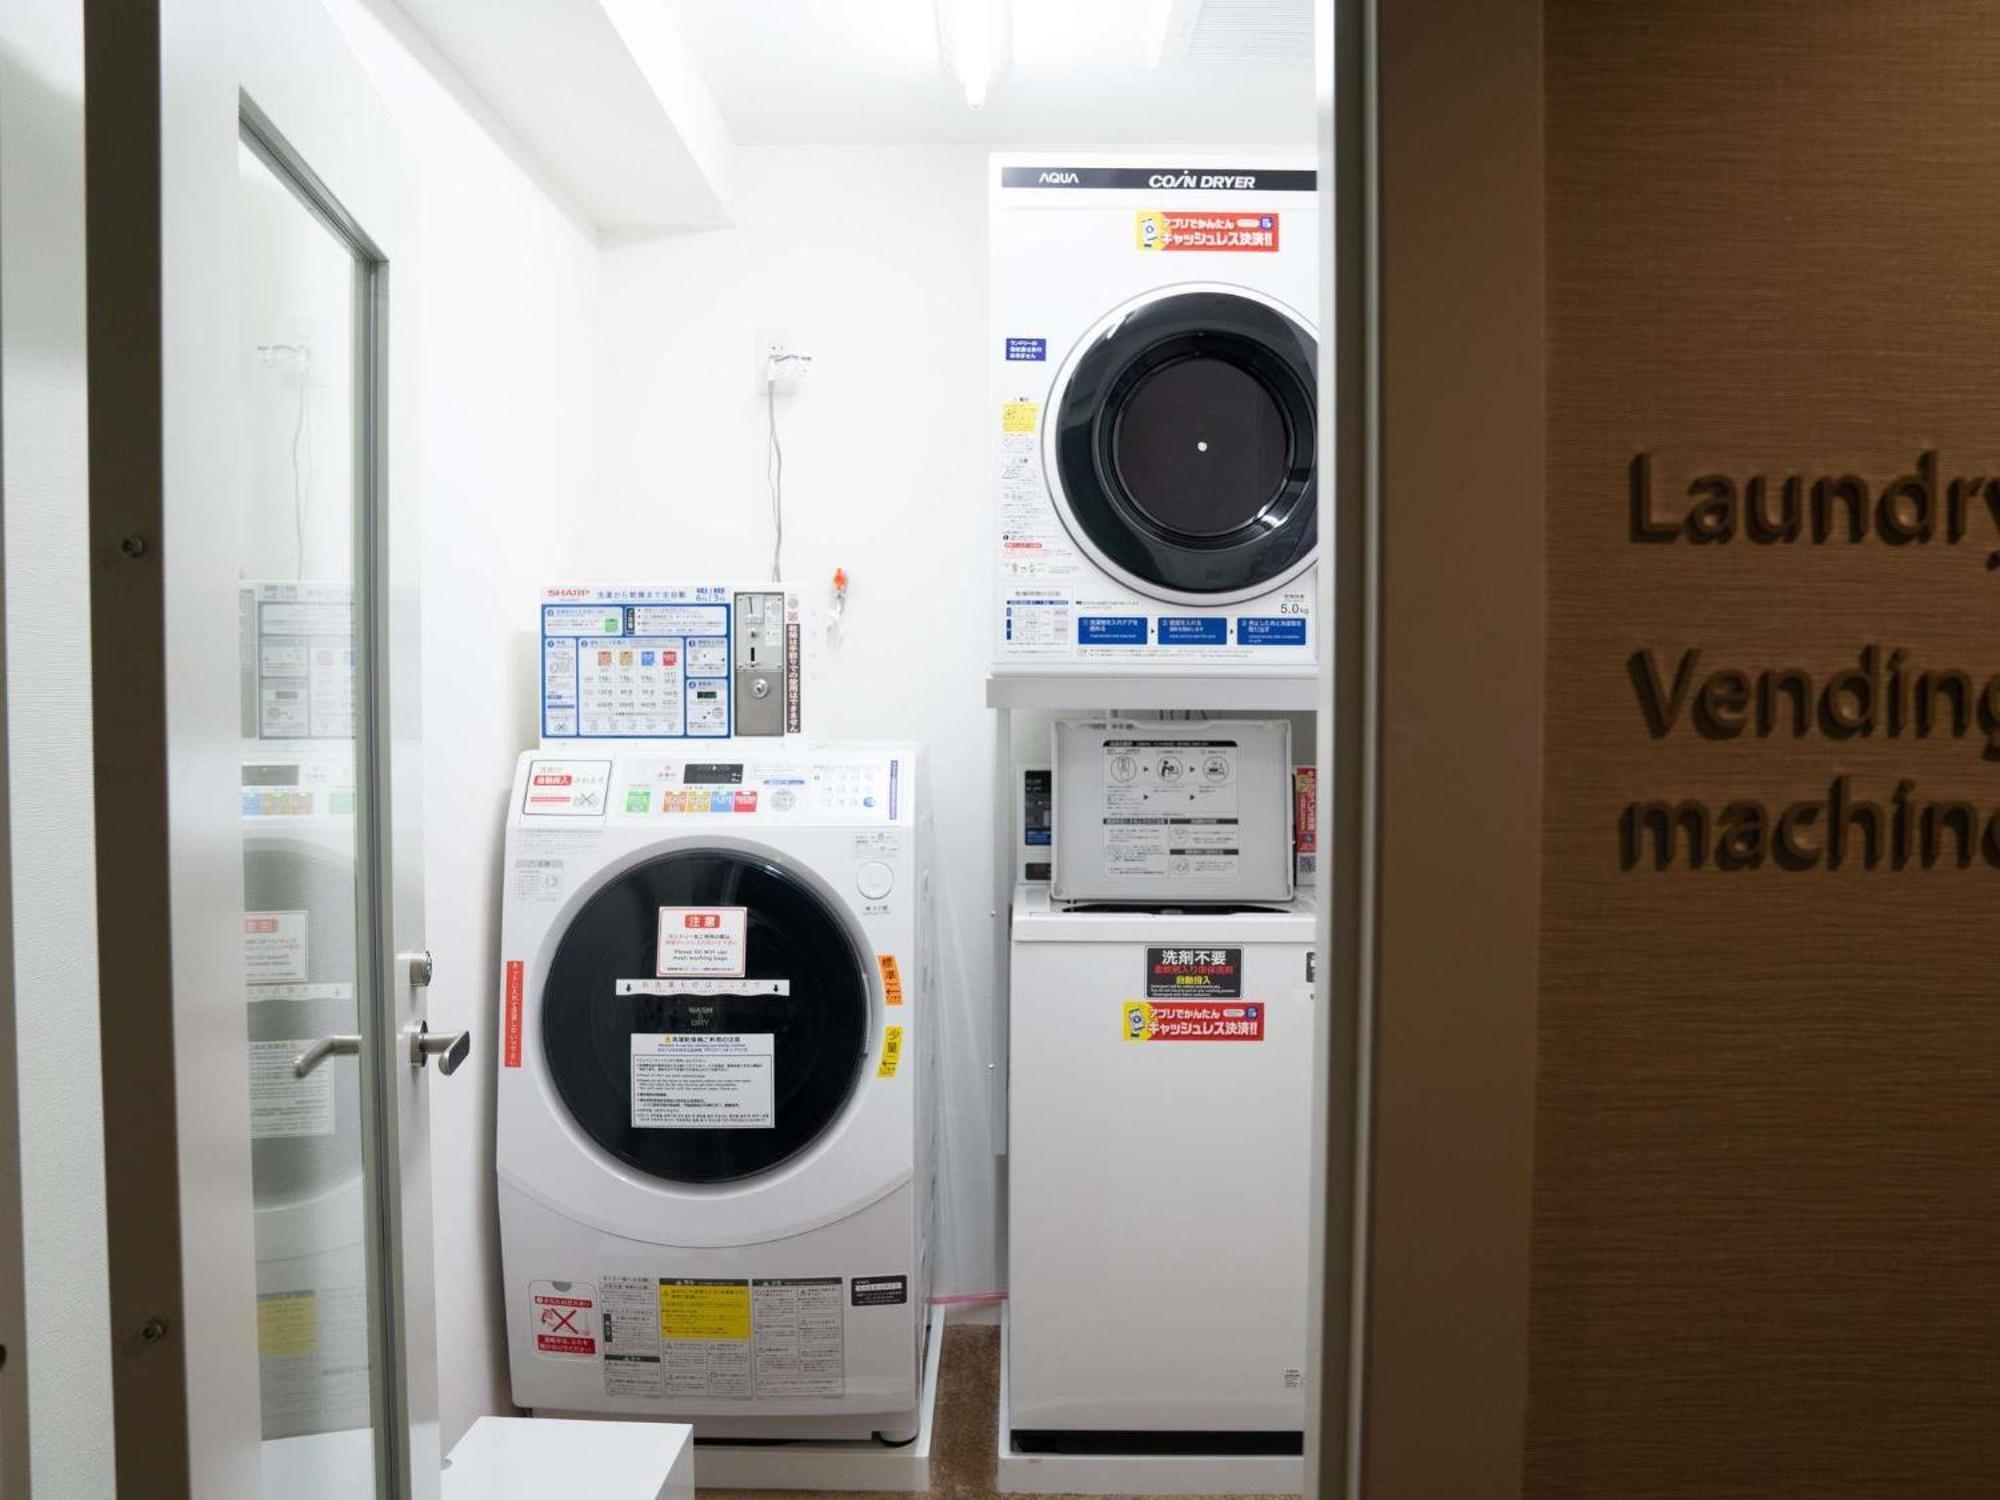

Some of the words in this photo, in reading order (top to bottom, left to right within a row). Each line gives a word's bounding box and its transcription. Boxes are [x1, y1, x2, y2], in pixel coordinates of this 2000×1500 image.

[1038, 172, 1079, 184] AQUA
[1200, 175, 1256, 189] DRYER
[1161, 950, 1227, 965] 洗剤不要
[1149, 1008, 1220, 1020] アプリでかんたん
